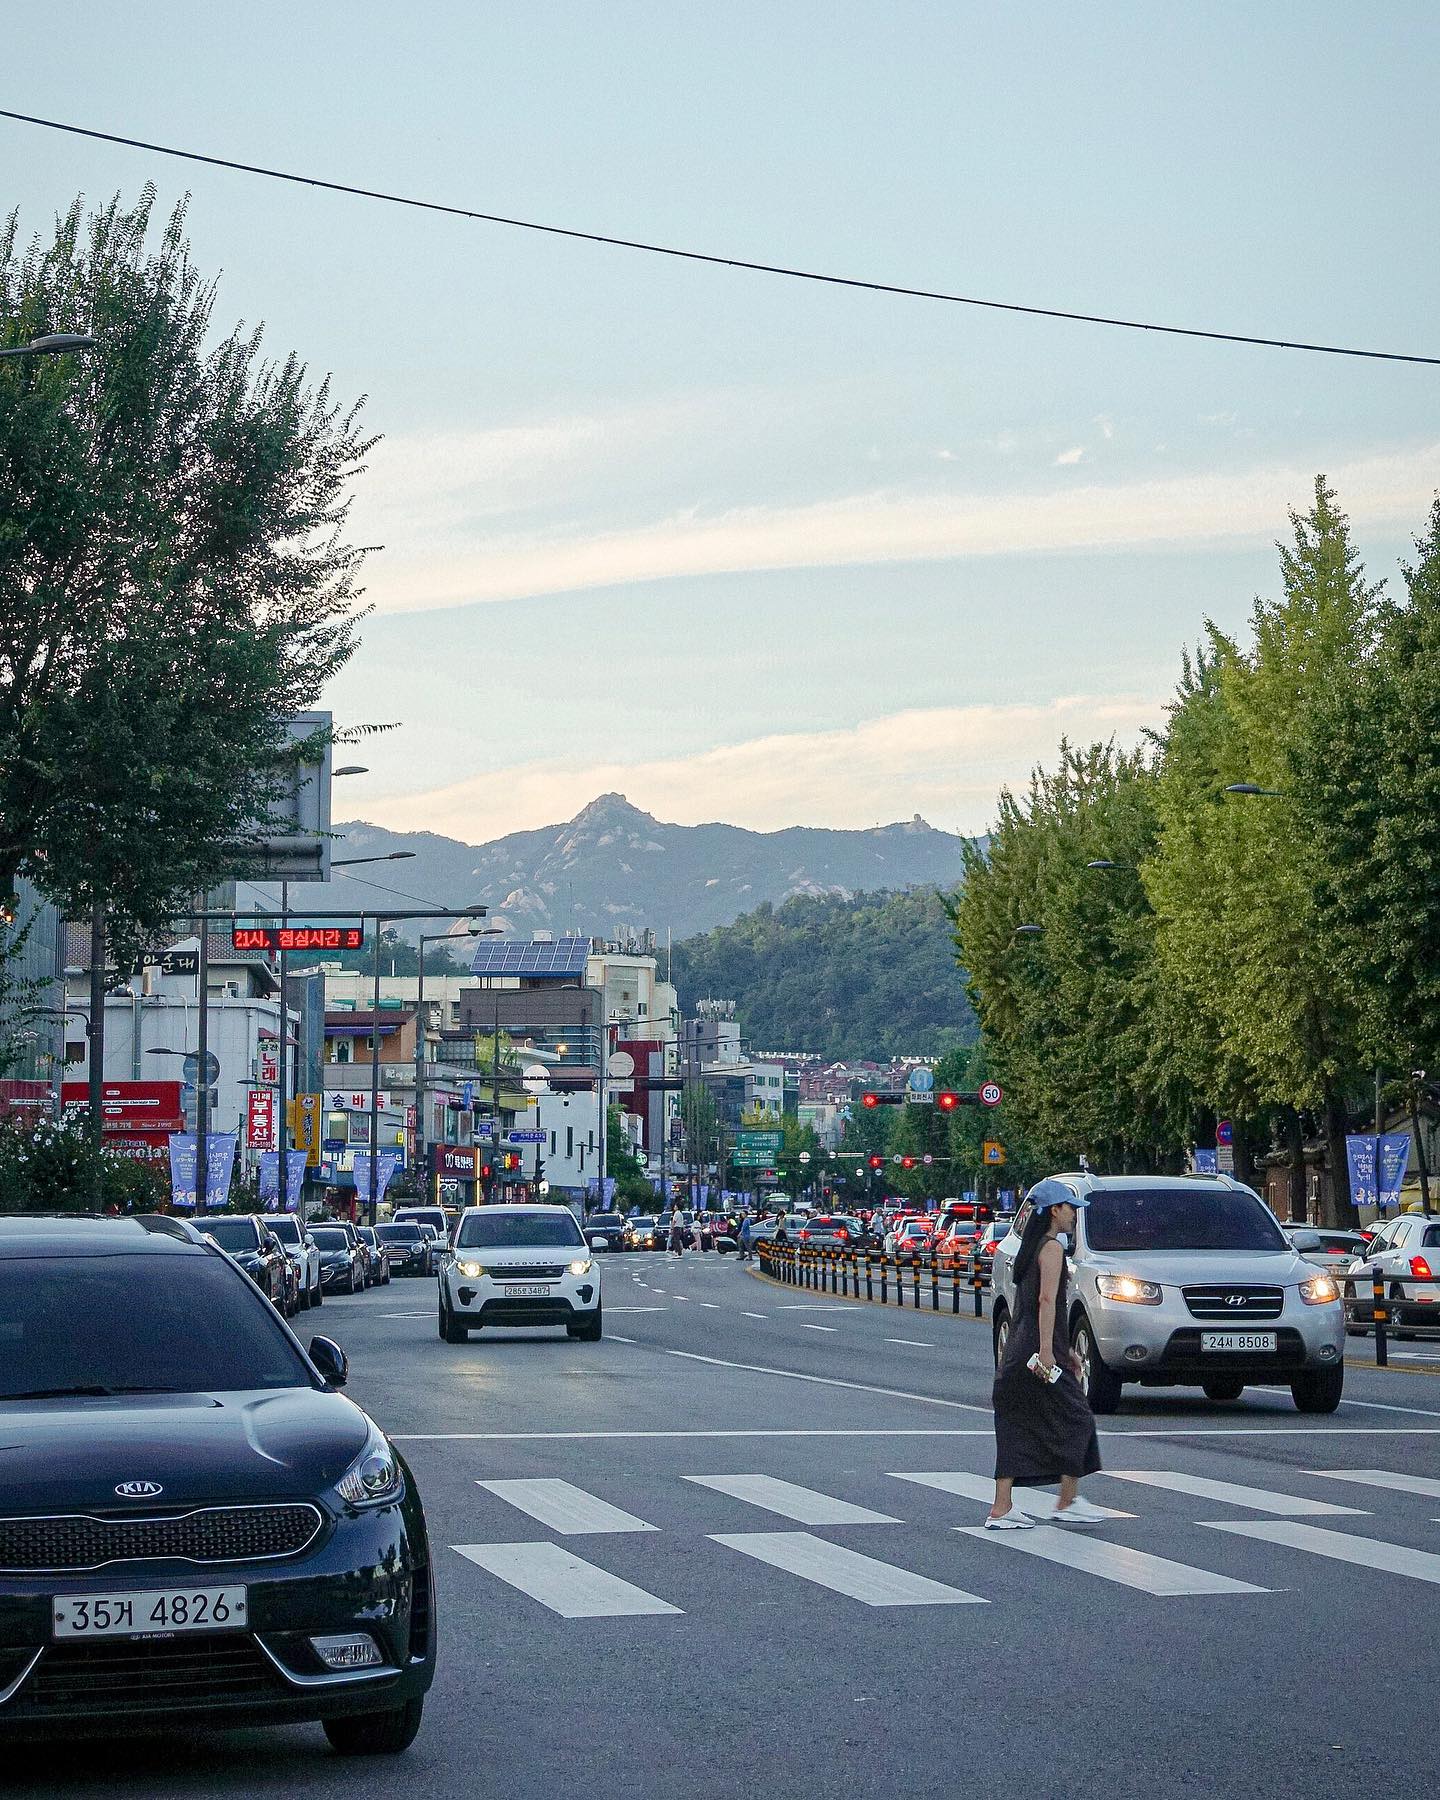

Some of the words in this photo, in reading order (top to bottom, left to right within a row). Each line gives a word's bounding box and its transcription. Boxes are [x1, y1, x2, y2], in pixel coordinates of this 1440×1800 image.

[236, 930, 270, 947] 21시,
[279, 930, 341, 947] 점심시간
[984, 1088, 999, 1099] 50
[251, 1101, 269, 1141] 부동산
[1209, 1336, 1233, 1348] 24서
[1238, 1336, 1269, 1348] 8508
[122, 1482, 155, 1493] KIA
[71, 1600, 134, 1631] 35거
[149, 1593, 231, 1627] 4826
